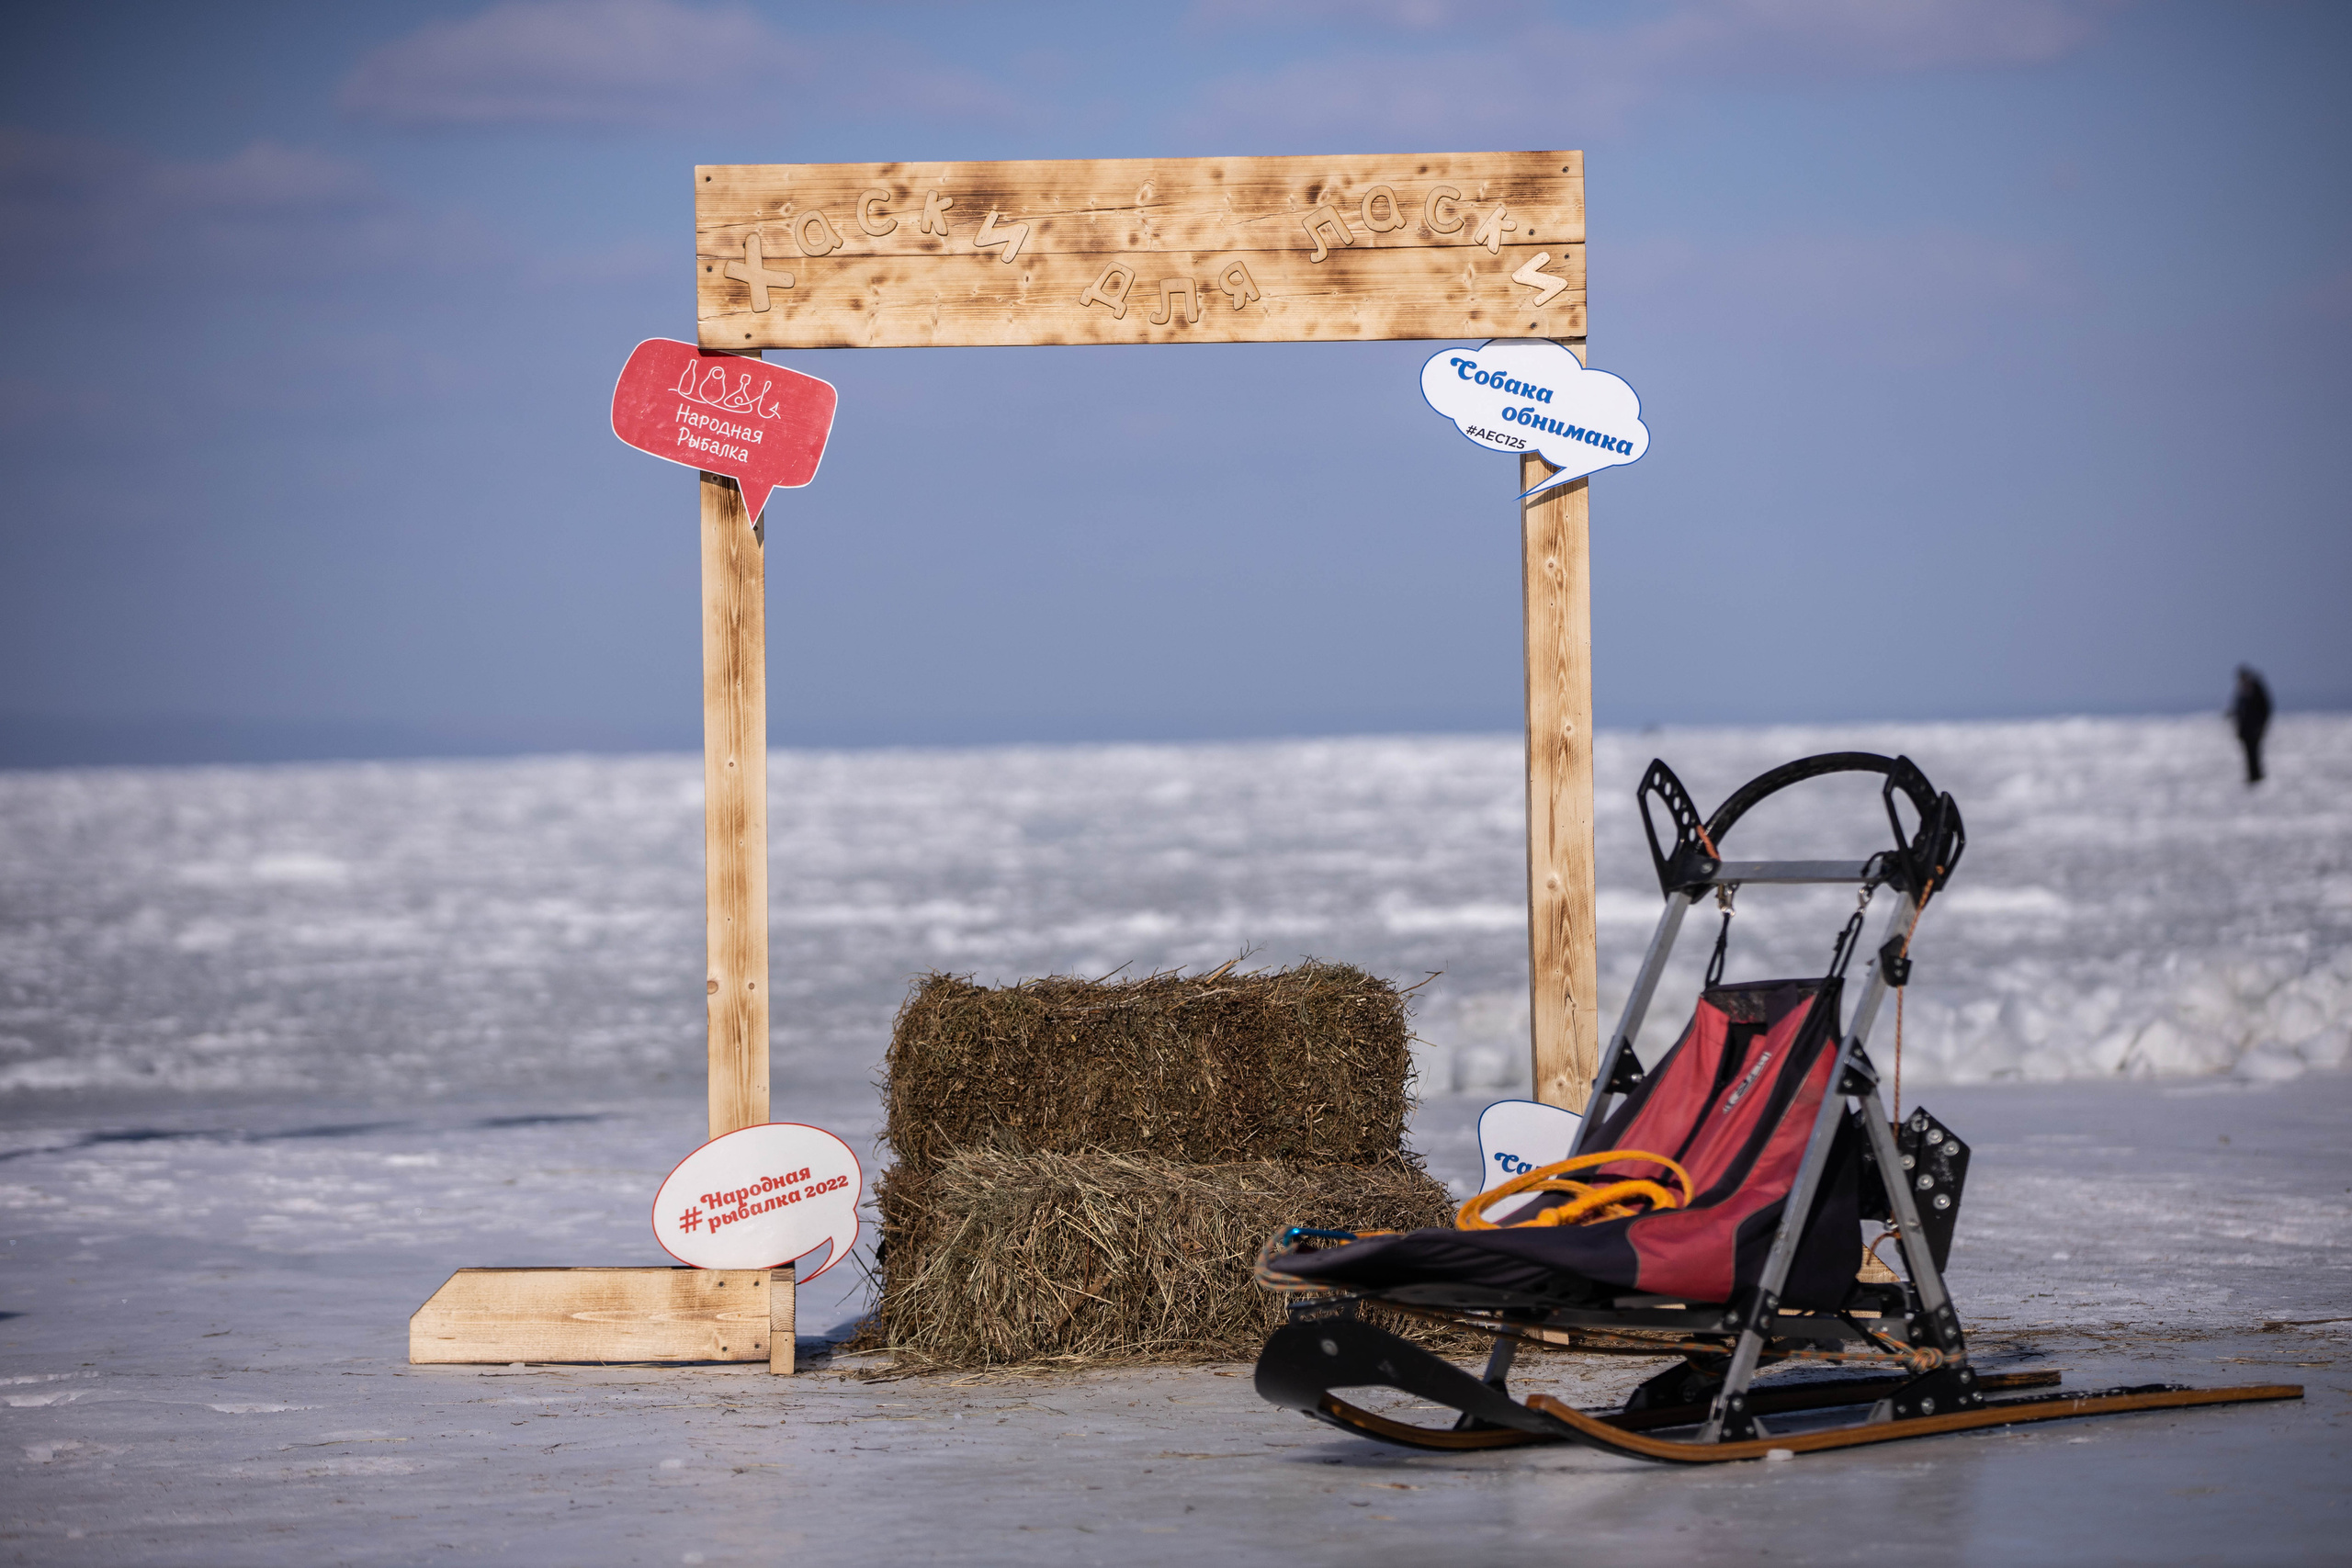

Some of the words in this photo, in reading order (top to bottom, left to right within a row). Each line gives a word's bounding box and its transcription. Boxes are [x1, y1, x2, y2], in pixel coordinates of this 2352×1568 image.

[724, 189, 1029, 312] Хаски
[1080, 261, 1261, 324] для
[1302, 186, 1569, 307] ласки
[1450, 356, 1554, 403] Собака
[675, 403, 763, 444] Народная
[677, 426, 749, 463] Рыбалка
[1501, 406, 1634, 456] обнимака
[707, 1188, 802, 1235] рыбалка
[804, 1175, 849, 1199] 2022
